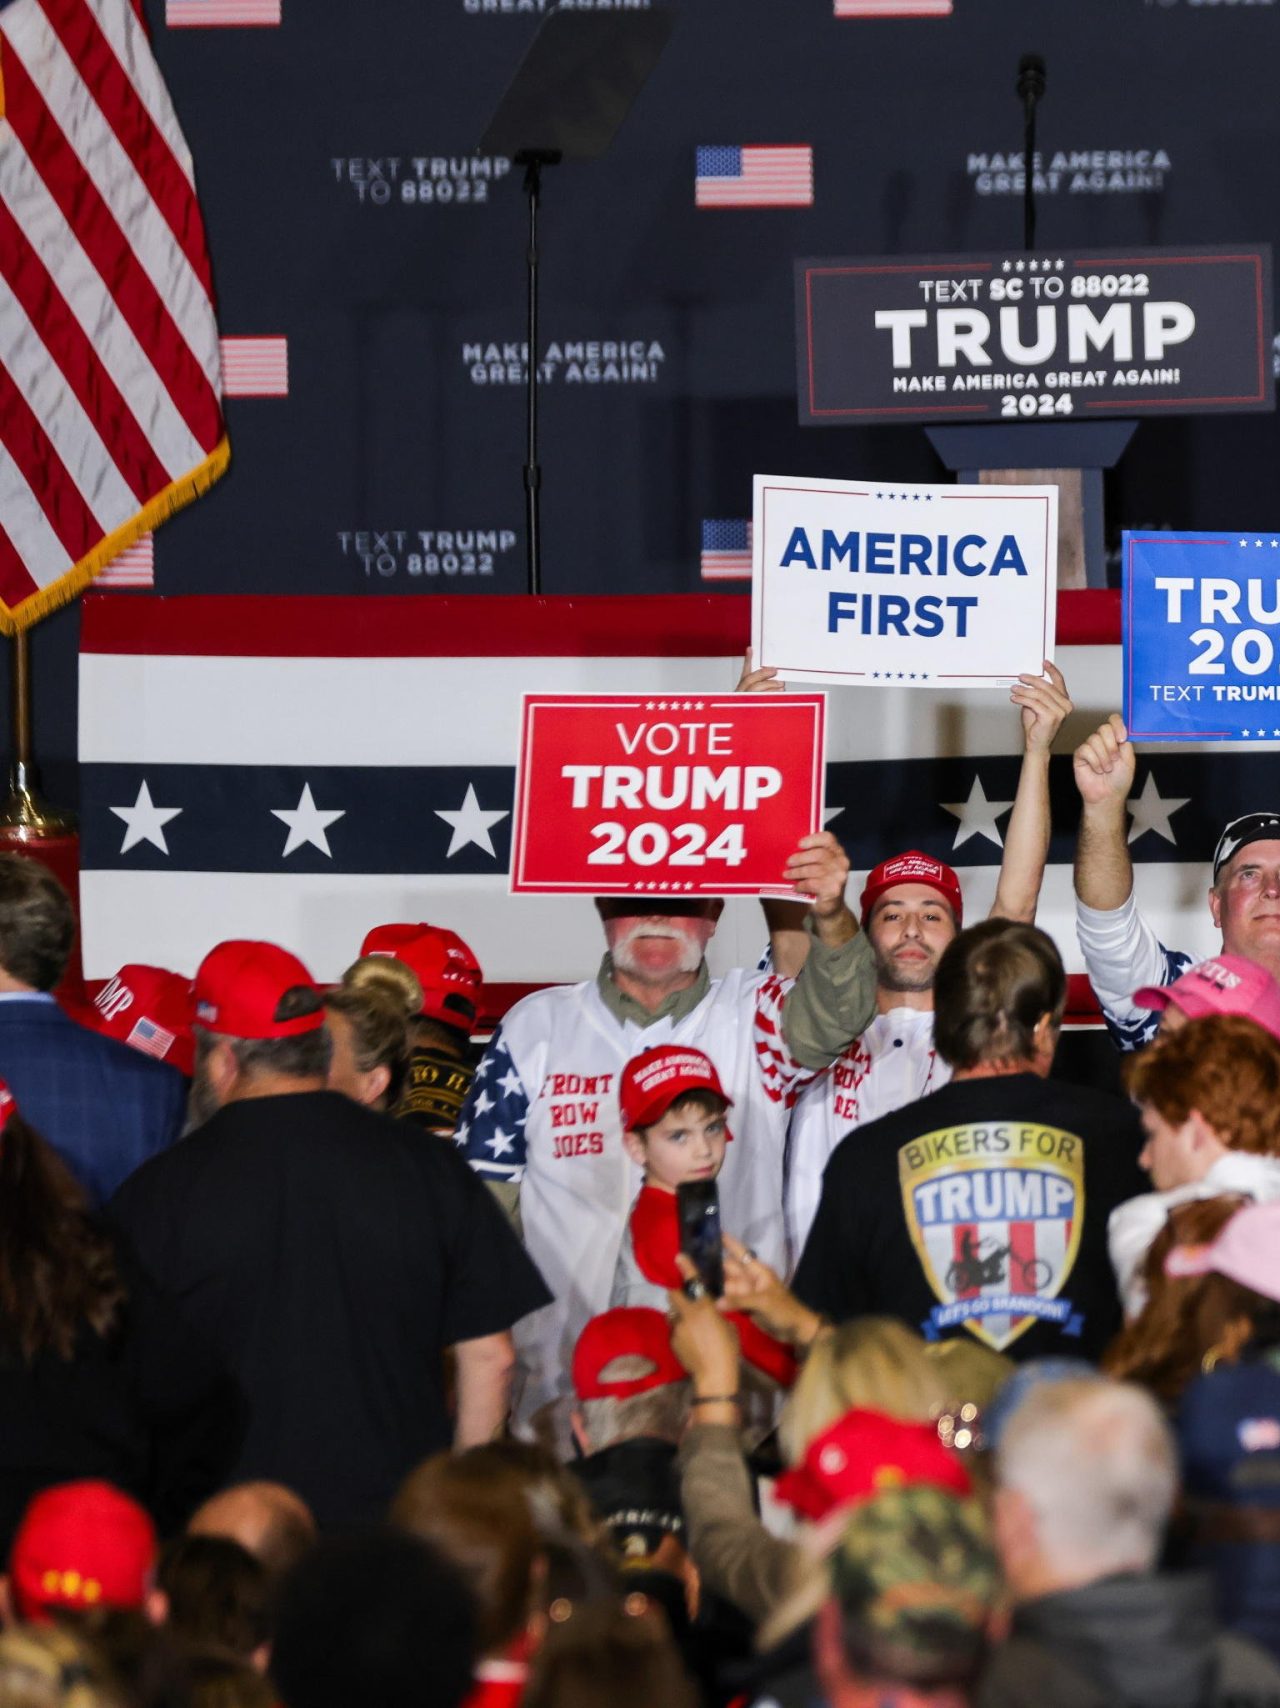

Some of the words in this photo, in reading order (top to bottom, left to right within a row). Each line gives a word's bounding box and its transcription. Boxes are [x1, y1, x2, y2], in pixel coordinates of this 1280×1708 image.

[331, 158, 399, 181] TEXT
[412, 157, 510, 179] TRUMP
[1050, 150, 1171, 171] AMERICA
[355, 180, 391, 204] TO
[401, 179, 488, 203] 88022
[975, 172, 1061, 195] GREAT
[919, 279, 983, 302] TEXT
[989, 277, 1023, 300] SC
[1029, 277, 1064, 299] TO
[1070, 274, 1149, 298] 88022
[875, 301, 1196, 368] TRUMP
[545, 340, 665, 361] AMERICA
[565, 361, 658, 383] AGAIN!
[893, 375, 946, 392] MAKE
[952, 373, 1039, 390] AMERICA
[1045, 371, 1107, 388] GREAT
[1112, 368, 1180, 386] AGAIN!
[1001, 394, 1073, 416] 2024
[337, 531, 406, 554] TEXT
[418, 530, 516, 552] TRUMP
[779, 526, 1029, 577] AMERICA
[364, 553, 397, 576] TO
[407, 553, 494, 576] 88022
[828, 591, 978, 638] FIRST
[1149, 685, 1204, 701] TEXT
[615, 722, 734, 756] VOTE
[561, 764, 783, 811] TRUMP
[587, 821, 748, 867] 2024
[550, 1102, 598, 1128] ROW
[553, 1132, 604, 1159] JOES
[905, 1127, 1011, 1170] BIKERS
[1019, 1128, 1076, 1162] FOR
[914, 1171, 1076, 1222] TRUMP
